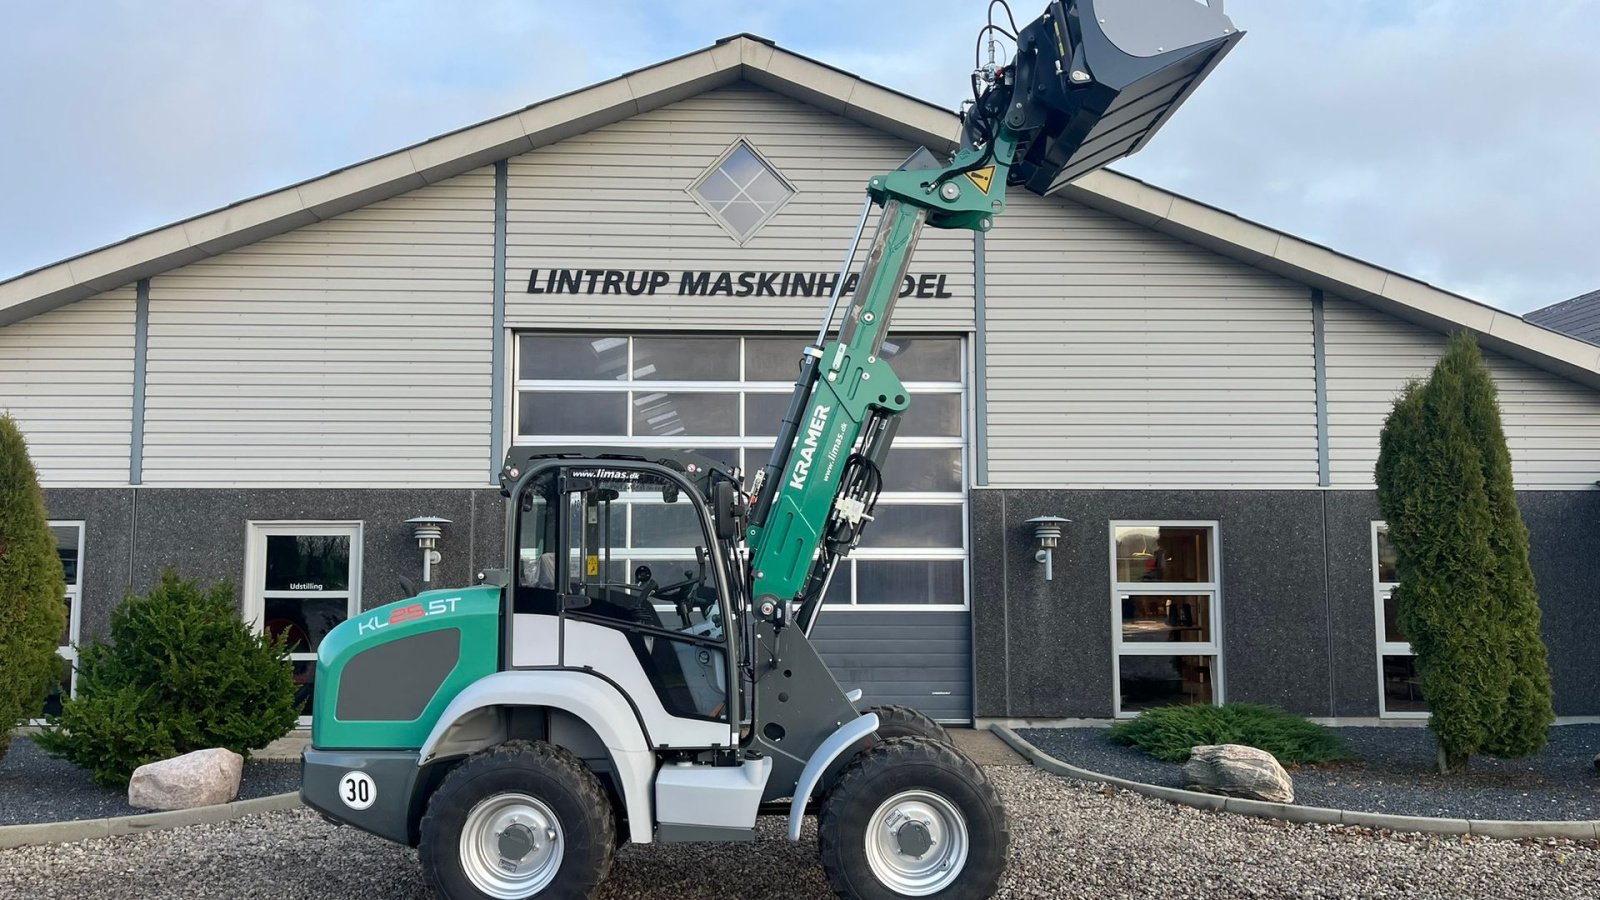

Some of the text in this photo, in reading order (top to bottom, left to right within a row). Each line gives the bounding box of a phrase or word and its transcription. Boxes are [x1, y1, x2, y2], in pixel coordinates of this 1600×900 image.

[527, 269, 952, 298] LINTRUP MASKINHADEL
[790, 405, 831, 489] KRAMER
[824, 422, 847, 482] www.limas.dk
[572, 469, 640, 480] www.limas.dk
[290, 582, 323, 590] Udstilling
[358, 597, 461, 635] KL25.5T
[346, 778, 369, 803] 30
